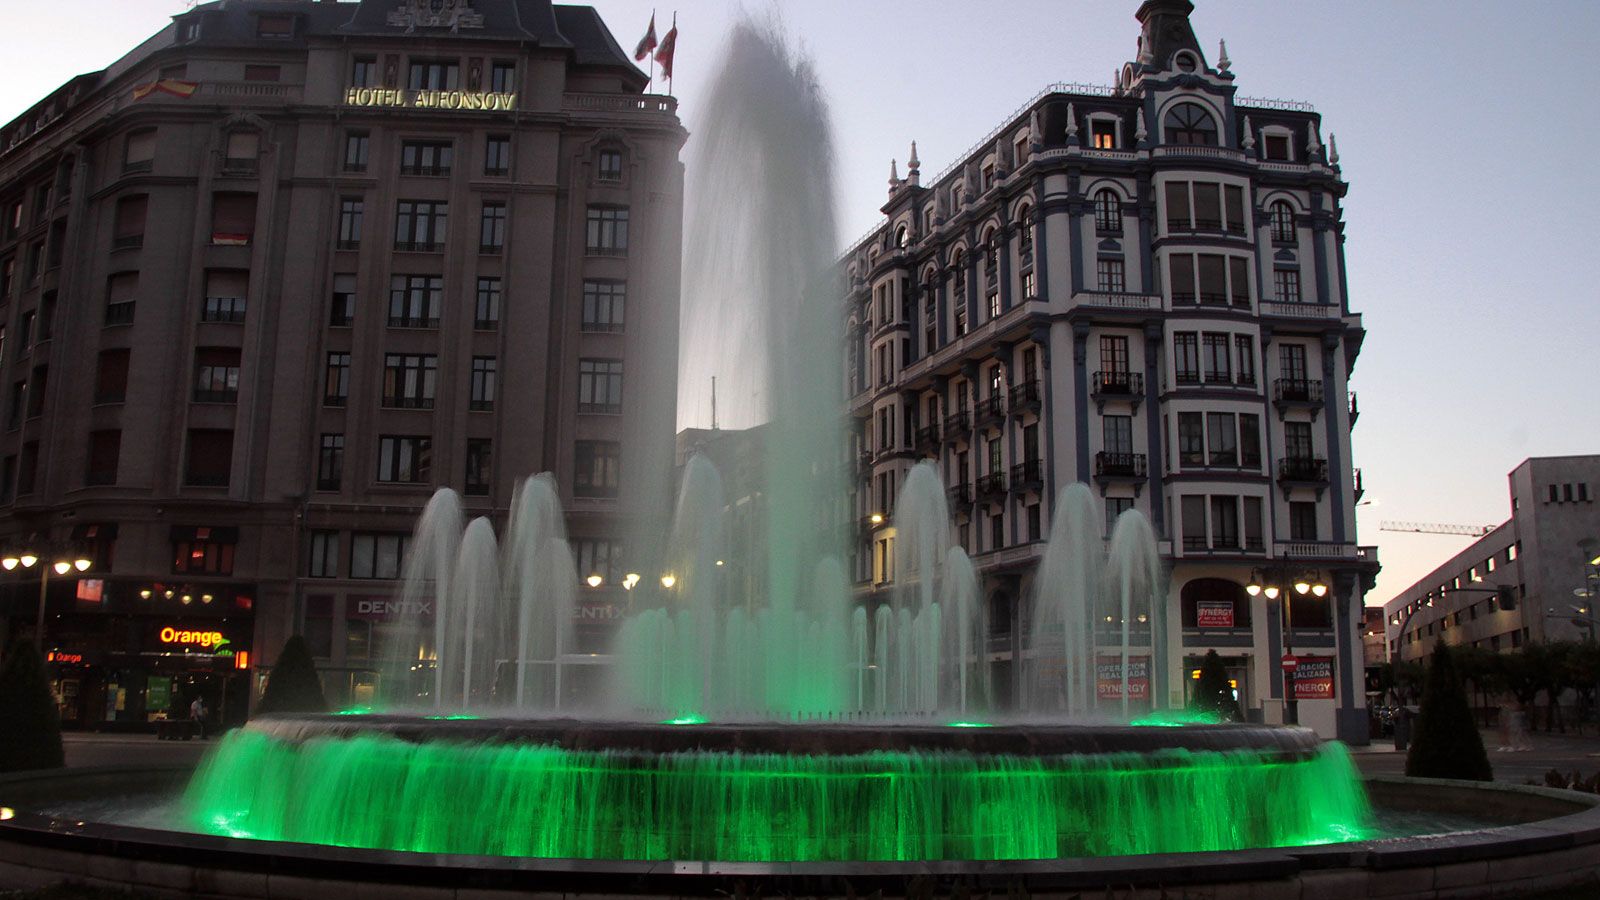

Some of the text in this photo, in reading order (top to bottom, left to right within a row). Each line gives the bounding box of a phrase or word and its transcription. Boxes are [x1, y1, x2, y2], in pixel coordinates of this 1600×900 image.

[345, 87, 405, 107] HOTEL
[358, 600, 431, 614] DENTIX
[1198, 608, 1232, 616] SYNERGY
[160, 626, 223, 647] Orange
[56, 652, 82, 663] Orange
[1296, 661, 1331, 672] ERACIÓN
[1293, 669, 1331, 679] EALIZADA
[1294, 683, 1331, 692] YNERGY
